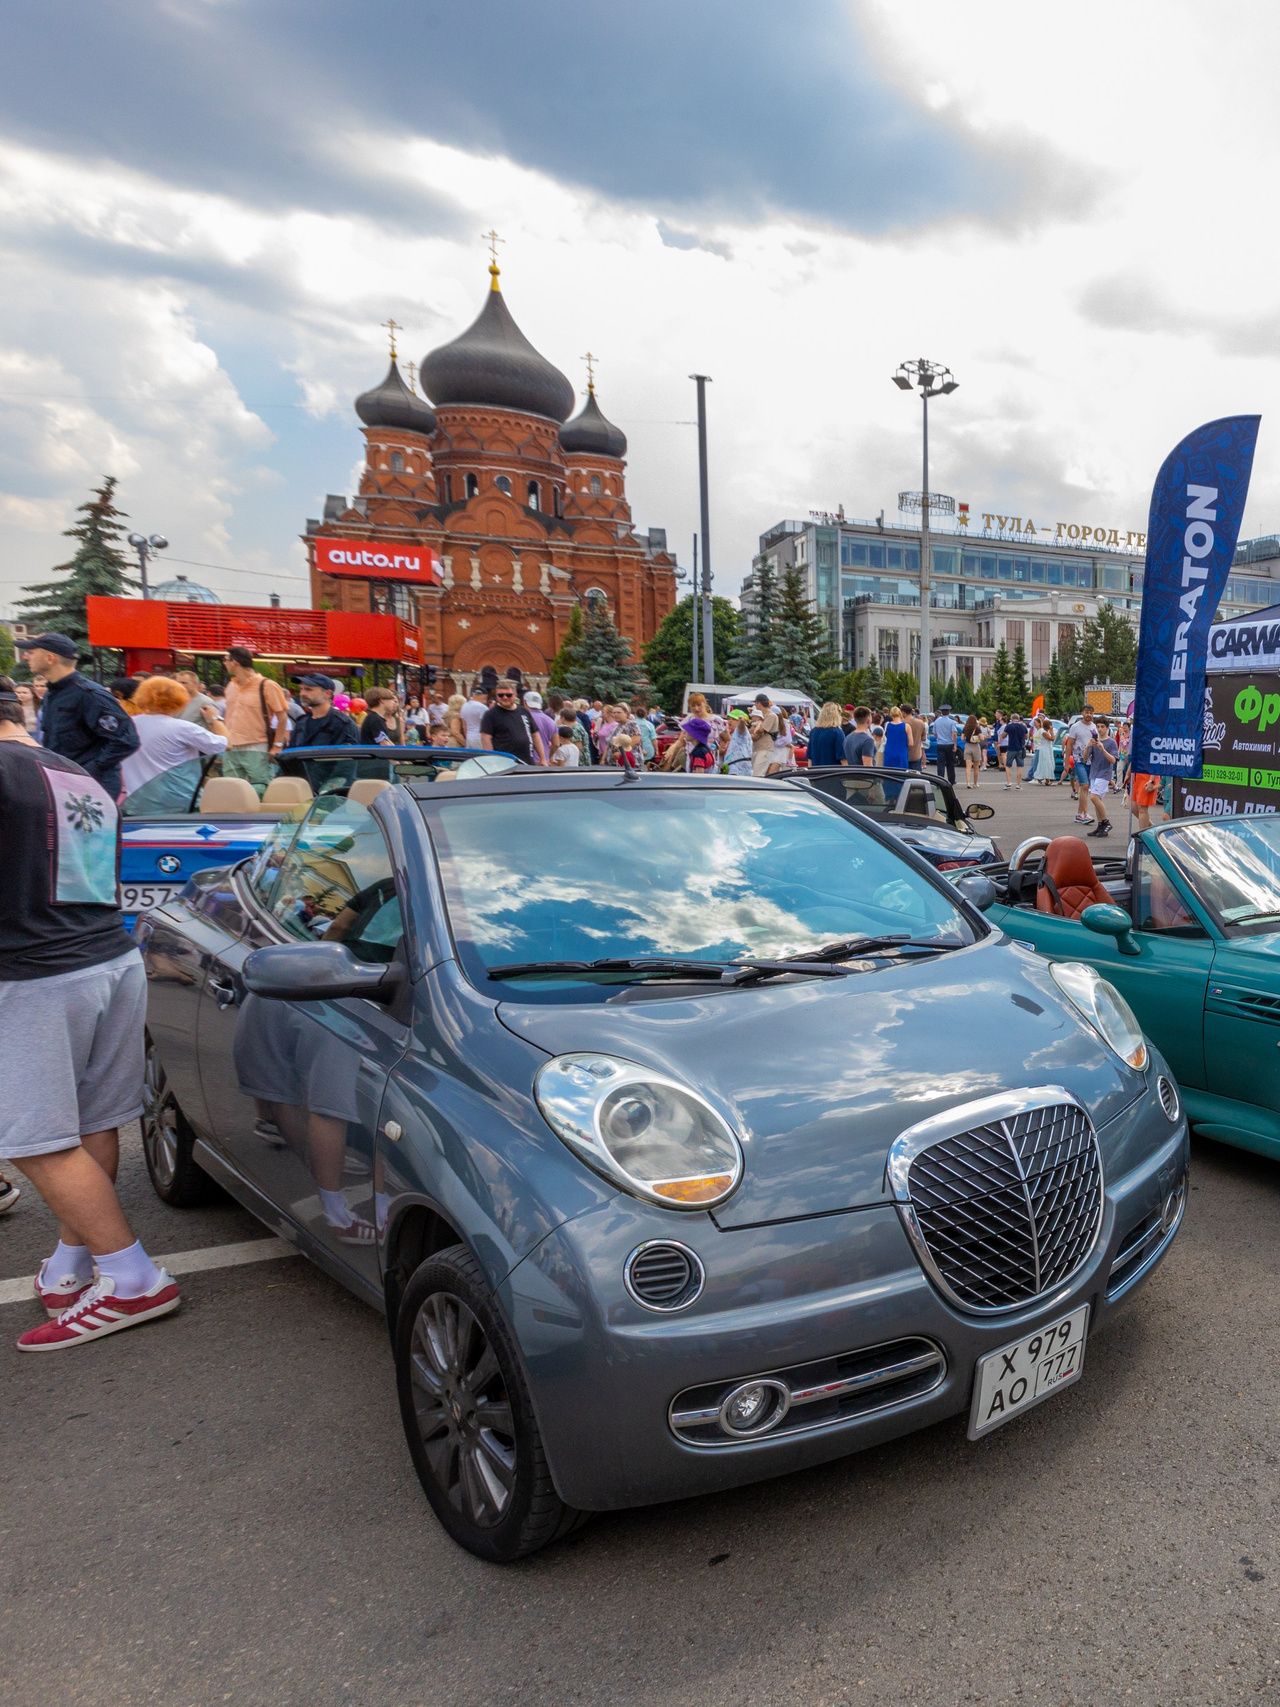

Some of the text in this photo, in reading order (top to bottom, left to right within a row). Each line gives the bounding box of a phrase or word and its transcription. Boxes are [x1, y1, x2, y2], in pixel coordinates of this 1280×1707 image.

[981, 513, 1037, 535] ТУЛА
[328, 549, 420, 570] auto.ru
[1169, 484, 1219, 710] LERATON
[1151, 736, 1196, 752] CARWASH
[1232, 739, 1272, 753] Автохимия
[1149, 752, 1195, 767] DETAILING
[124, 888, 179, 908] 957
[1028, 1320, 1072, 1364] 979
[1043, 1345, 1078, 1381] 777
[1047, 1372, 1063, 1387] RUS
